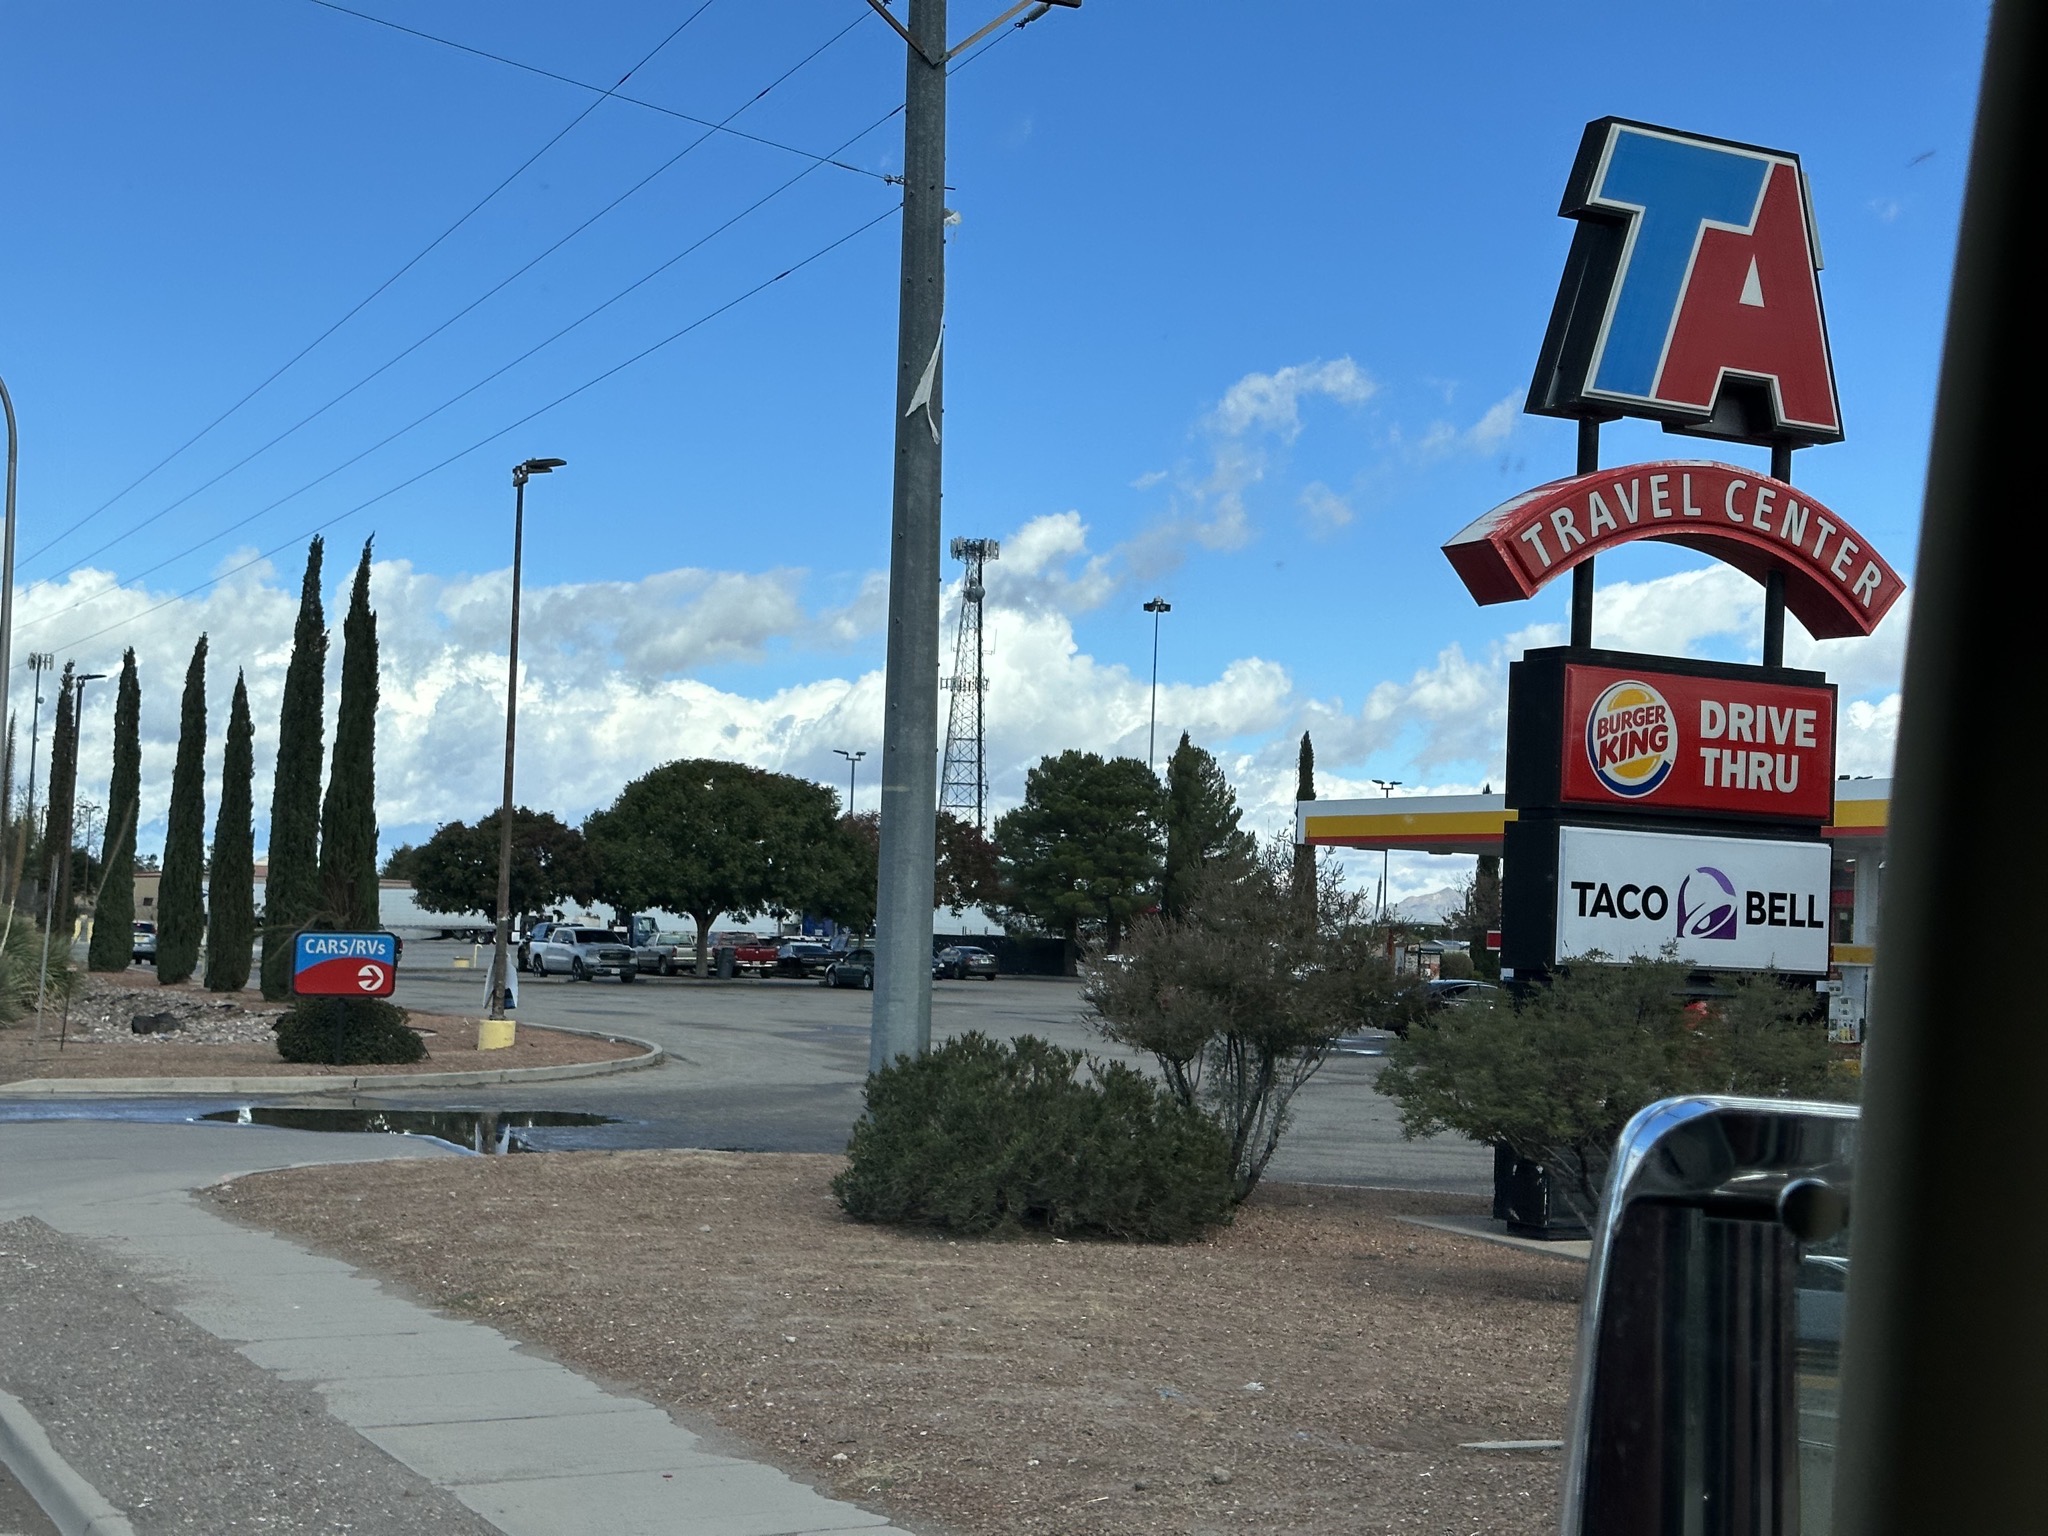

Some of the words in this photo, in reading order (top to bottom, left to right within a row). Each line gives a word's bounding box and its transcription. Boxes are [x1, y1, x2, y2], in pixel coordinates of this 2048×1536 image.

[1581, 122, 1840, 434] TA
[1520, 473, 1703, 568] TRAVEL
[1724, 479, 1883, 609] CENTER
[1596, 704, 1667, 741] BURGER
[1700, 699, 1817, 748] DRIVE
[1598, 723, 1669, 770] KING
[1700, 747, 1799, 793] THRU
[1570, 881, 1669, 921] TACO
[1745, 890, 1824, 928] BELL
[305, 938, 386, 955] CARS/RVs
